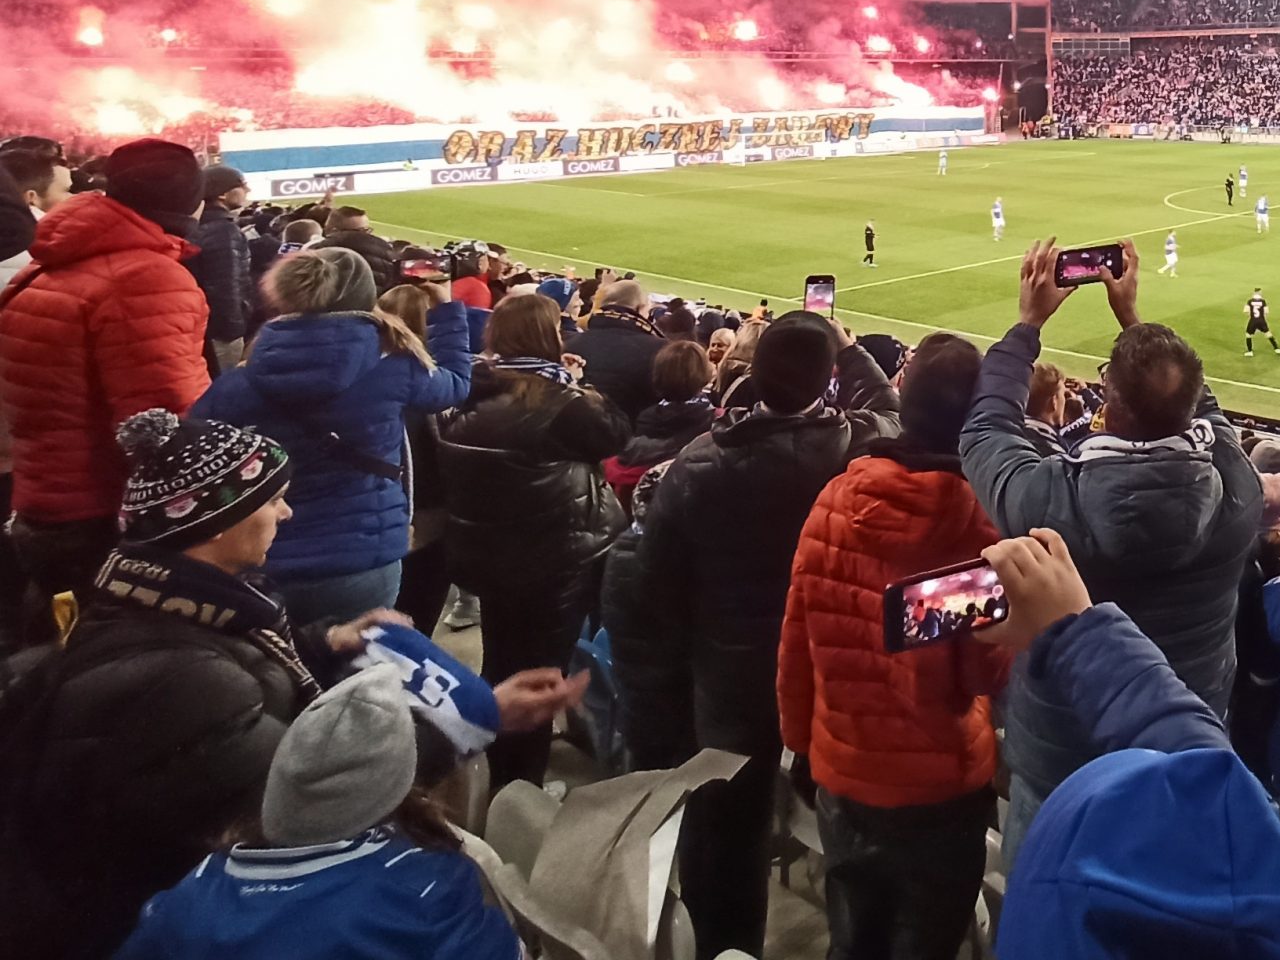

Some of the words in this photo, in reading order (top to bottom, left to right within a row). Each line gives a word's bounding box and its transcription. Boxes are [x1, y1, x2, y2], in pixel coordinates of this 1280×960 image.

[678, 152, 719, 166] GOMEZ
[773, 147, 811, 158] GOMEZ
[567, 159, 615, 173] GOMEZ
[436, 168, 492, 183] GOMEZ
[279, 176, 347, 195] GOMEZ
